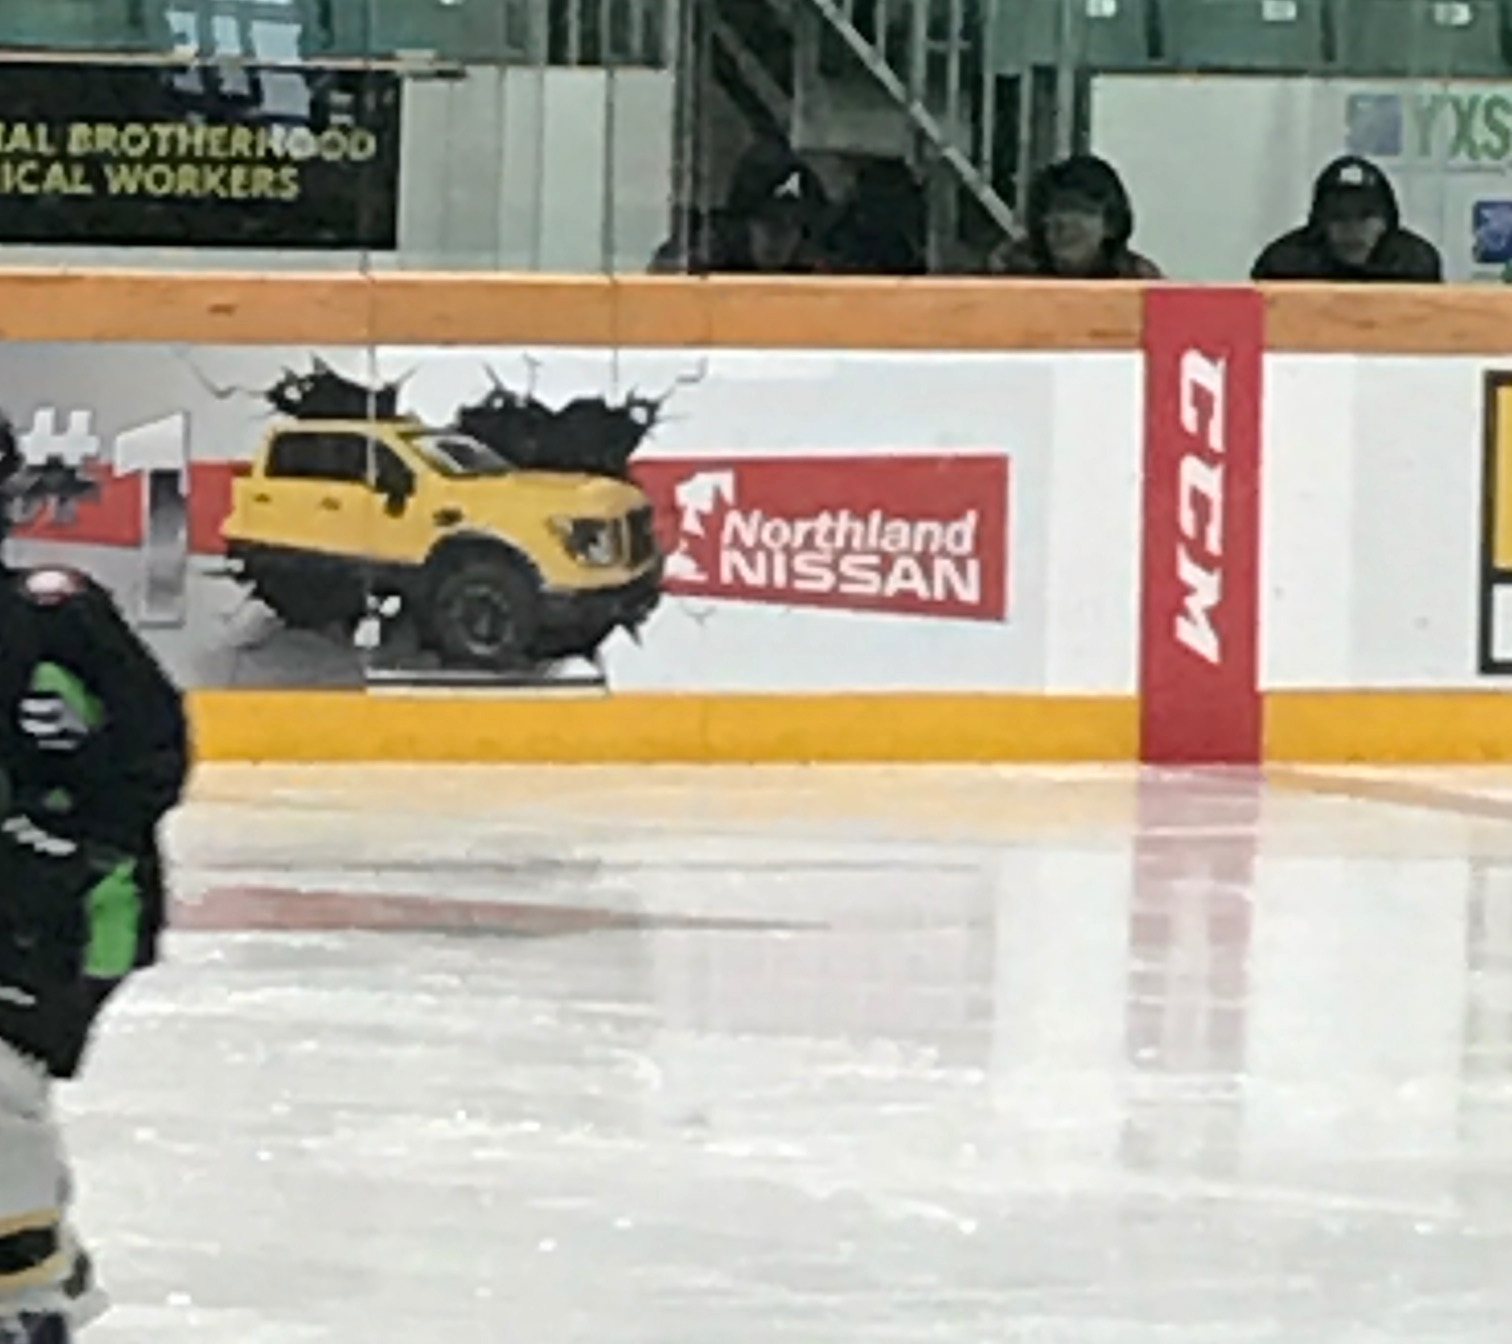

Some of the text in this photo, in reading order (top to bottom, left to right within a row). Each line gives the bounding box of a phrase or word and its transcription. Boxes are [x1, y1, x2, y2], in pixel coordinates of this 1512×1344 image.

[66, 120, 378, 163] BROTHERHOOD
[104, 164, 300, 201] WORKERS
[1174, 346, 1226, 666] CCM
[720, 508, 979, 555] Northland
[719, 550, 982, 605] NISSAN
